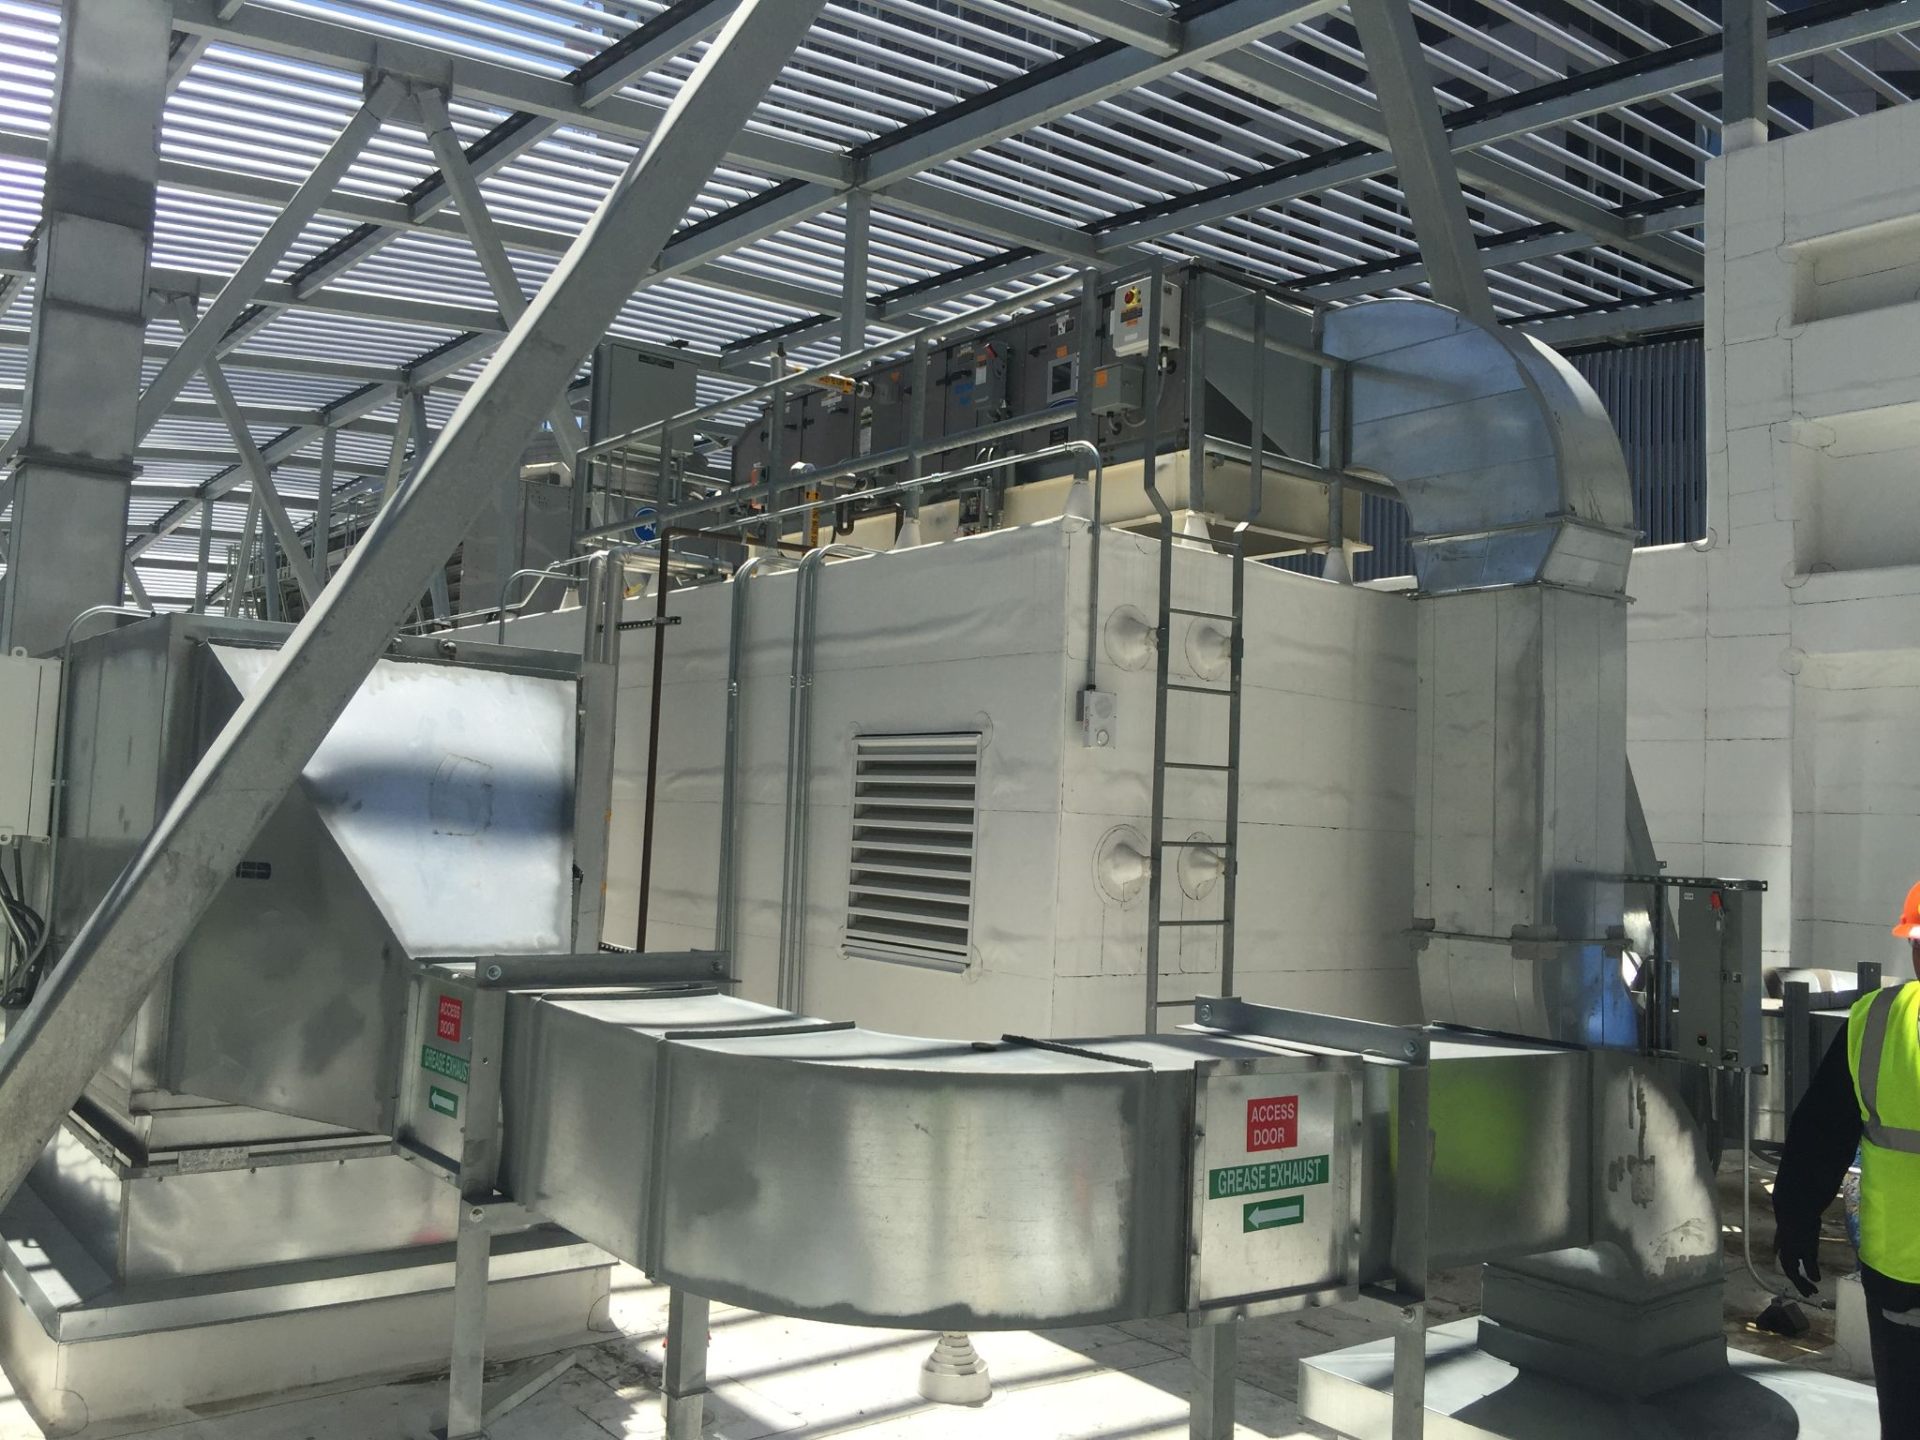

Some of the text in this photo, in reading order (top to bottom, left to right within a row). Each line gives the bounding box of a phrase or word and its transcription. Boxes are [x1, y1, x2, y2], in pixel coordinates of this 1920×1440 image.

[440, 1001, 461, 1020] ACCESS
[440, 1020, 456, 1037] DOOR
[424, 1048, 446, 1073] GREASE
[1251, 1103, 1295, 1123] ACCESS
[1253, 1127, 1285, 1146] DOOR
[1218, 1158, 1322, 1195] GREASE EXHAUST
